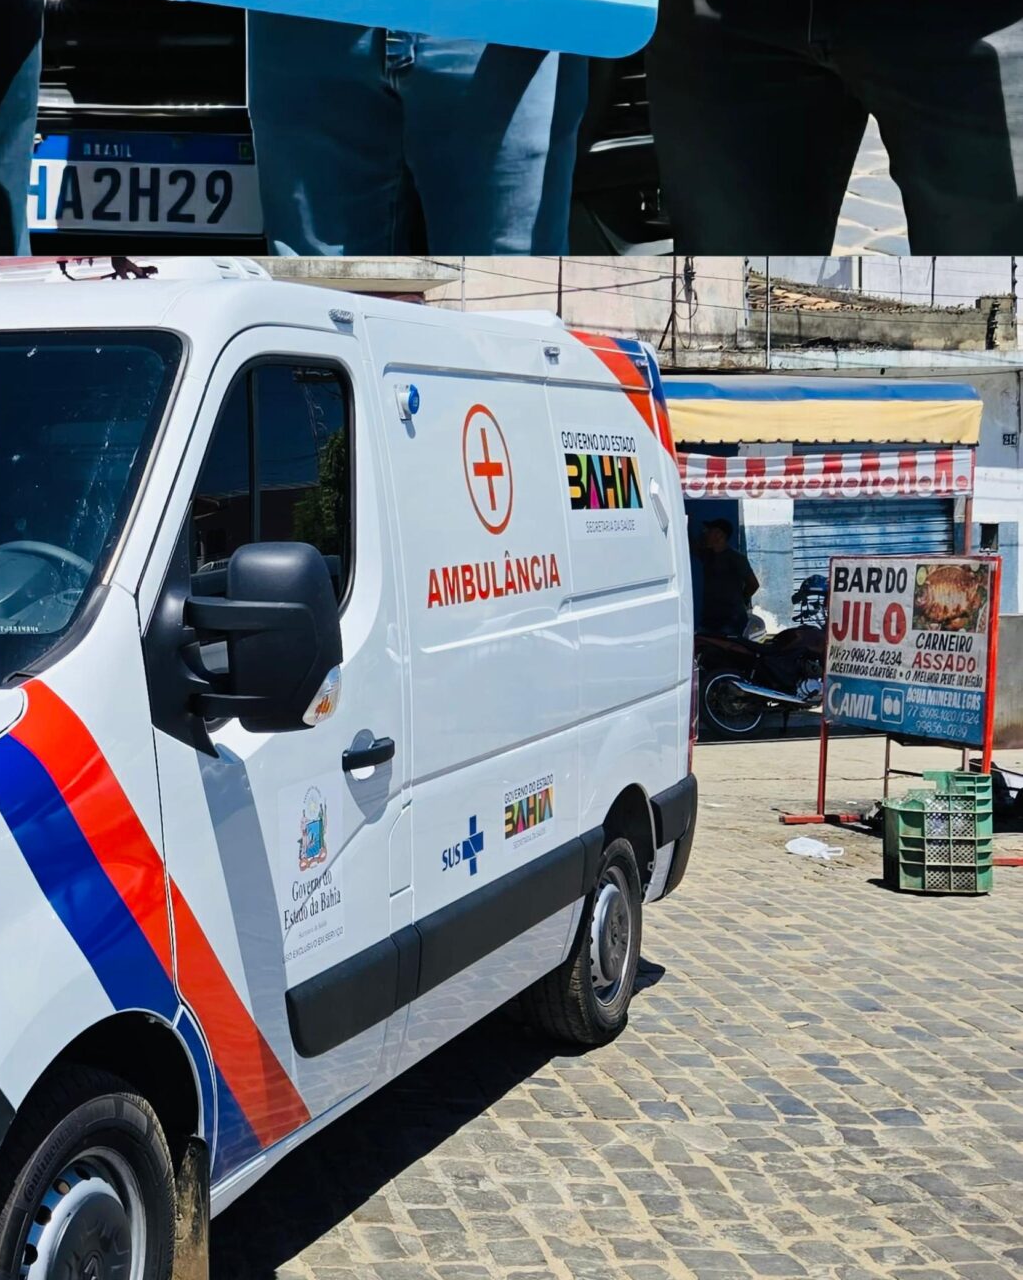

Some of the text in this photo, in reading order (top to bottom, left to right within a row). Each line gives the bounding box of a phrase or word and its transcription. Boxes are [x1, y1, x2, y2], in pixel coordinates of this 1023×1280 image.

[83, 143, 133, 158] BRASIL
[27, 164, 234, 225] HA2H29
[561, 431, 636, 453] GOVERNO DO ESTADO
[564, 453, 644, 510] BAHIA
[428, 550, 561, 609] AMBULÂNCIA
[833, 567, 908, 594] BAR DO
[832, 601, 907, 645] JILO
[915, 633, 974, 653] CARNEIRO
[830, 663, 869, 678] ACEITAMOS
[869, 666, 898, 680] CARTÕES
[912, 651, 976, 673] ASSADO
[828, 682, 878, 721] CAMIL
[927, 688, 961, 709] MINERAL
[504, 773, 554, 804] GOVERNO DO ESTADO
[504, 786, 554, 840] BAHIA
[442, 843, 461, 872] SUS
[310, 896, 318, 917] da
[320, 886, 341, 911] Bahia
